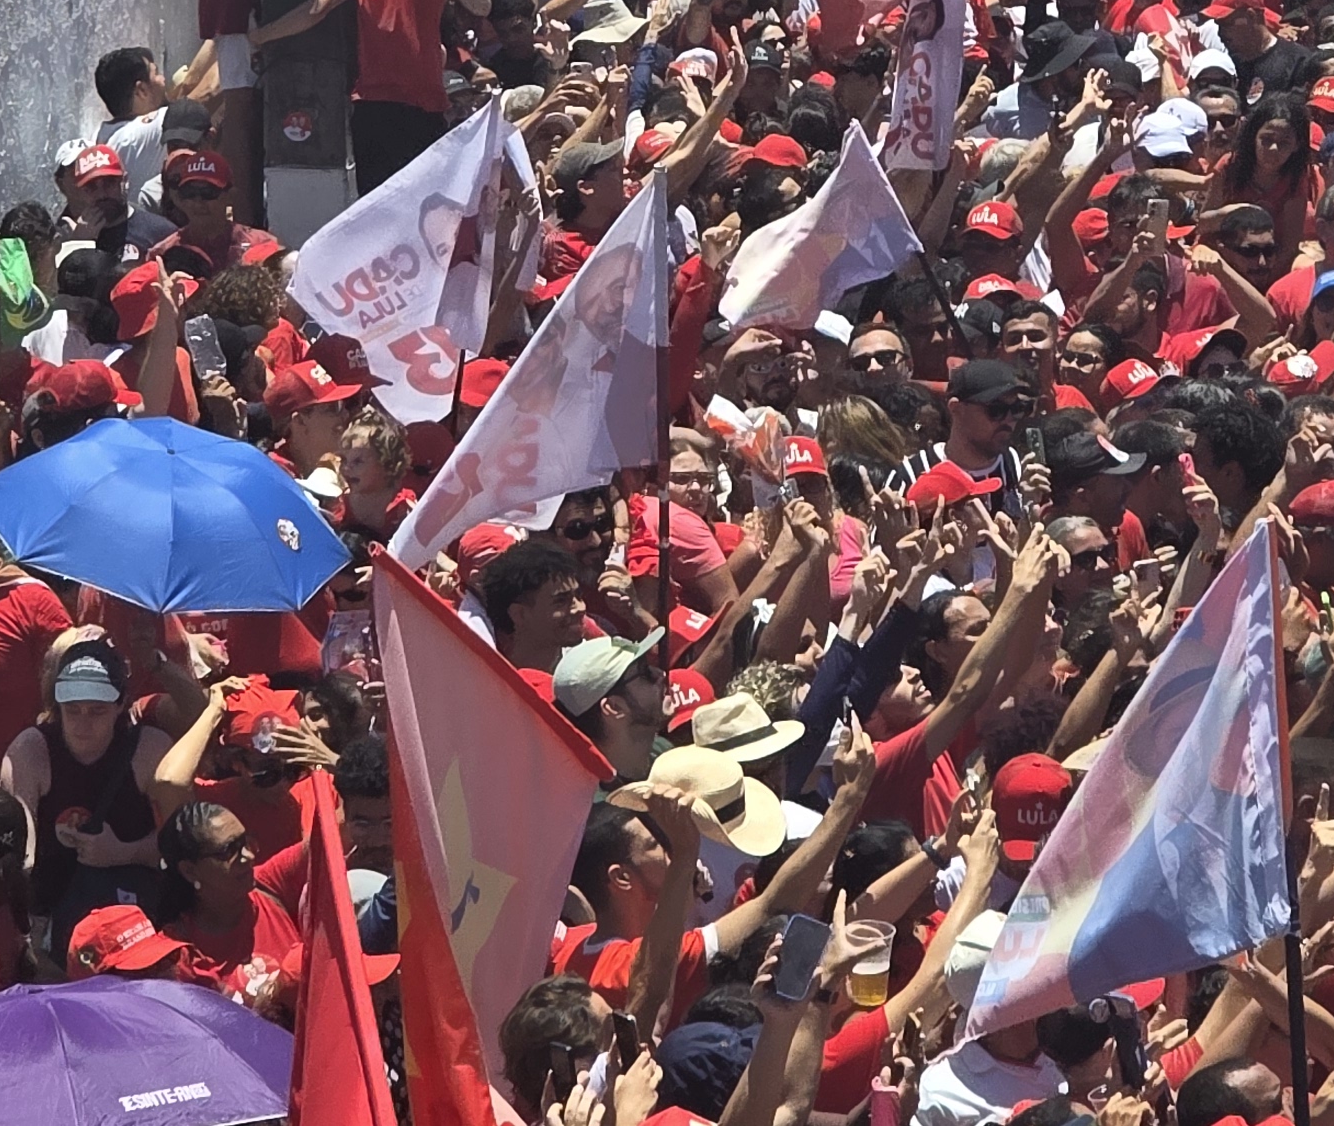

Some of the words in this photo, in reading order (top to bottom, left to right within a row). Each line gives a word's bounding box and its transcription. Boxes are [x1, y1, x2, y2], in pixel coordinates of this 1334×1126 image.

[909, 52, 934, 161] CADU
[187, 160, 215, 174] LULA
[971, 208, 998, 225] LULA
[1018, 808, 1058, 825] LULA
